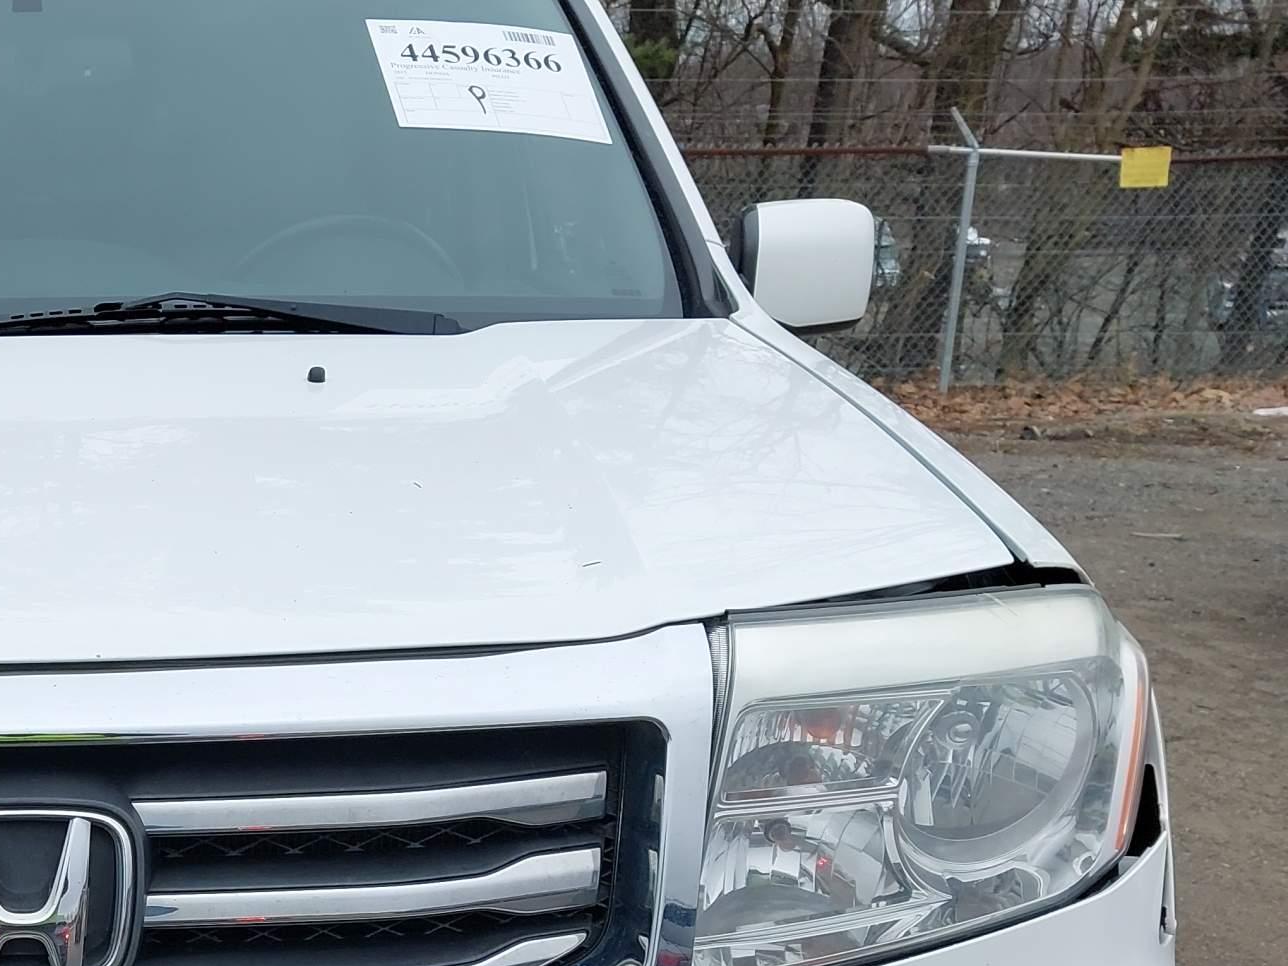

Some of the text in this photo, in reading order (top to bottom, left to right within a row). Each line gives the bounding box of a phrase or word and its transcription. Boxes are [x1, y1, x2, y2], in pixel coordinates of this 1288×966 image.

[390, 62, 521, 74] Progressive Casualty Insurance
[400, 43, 562, 73] 44596366
